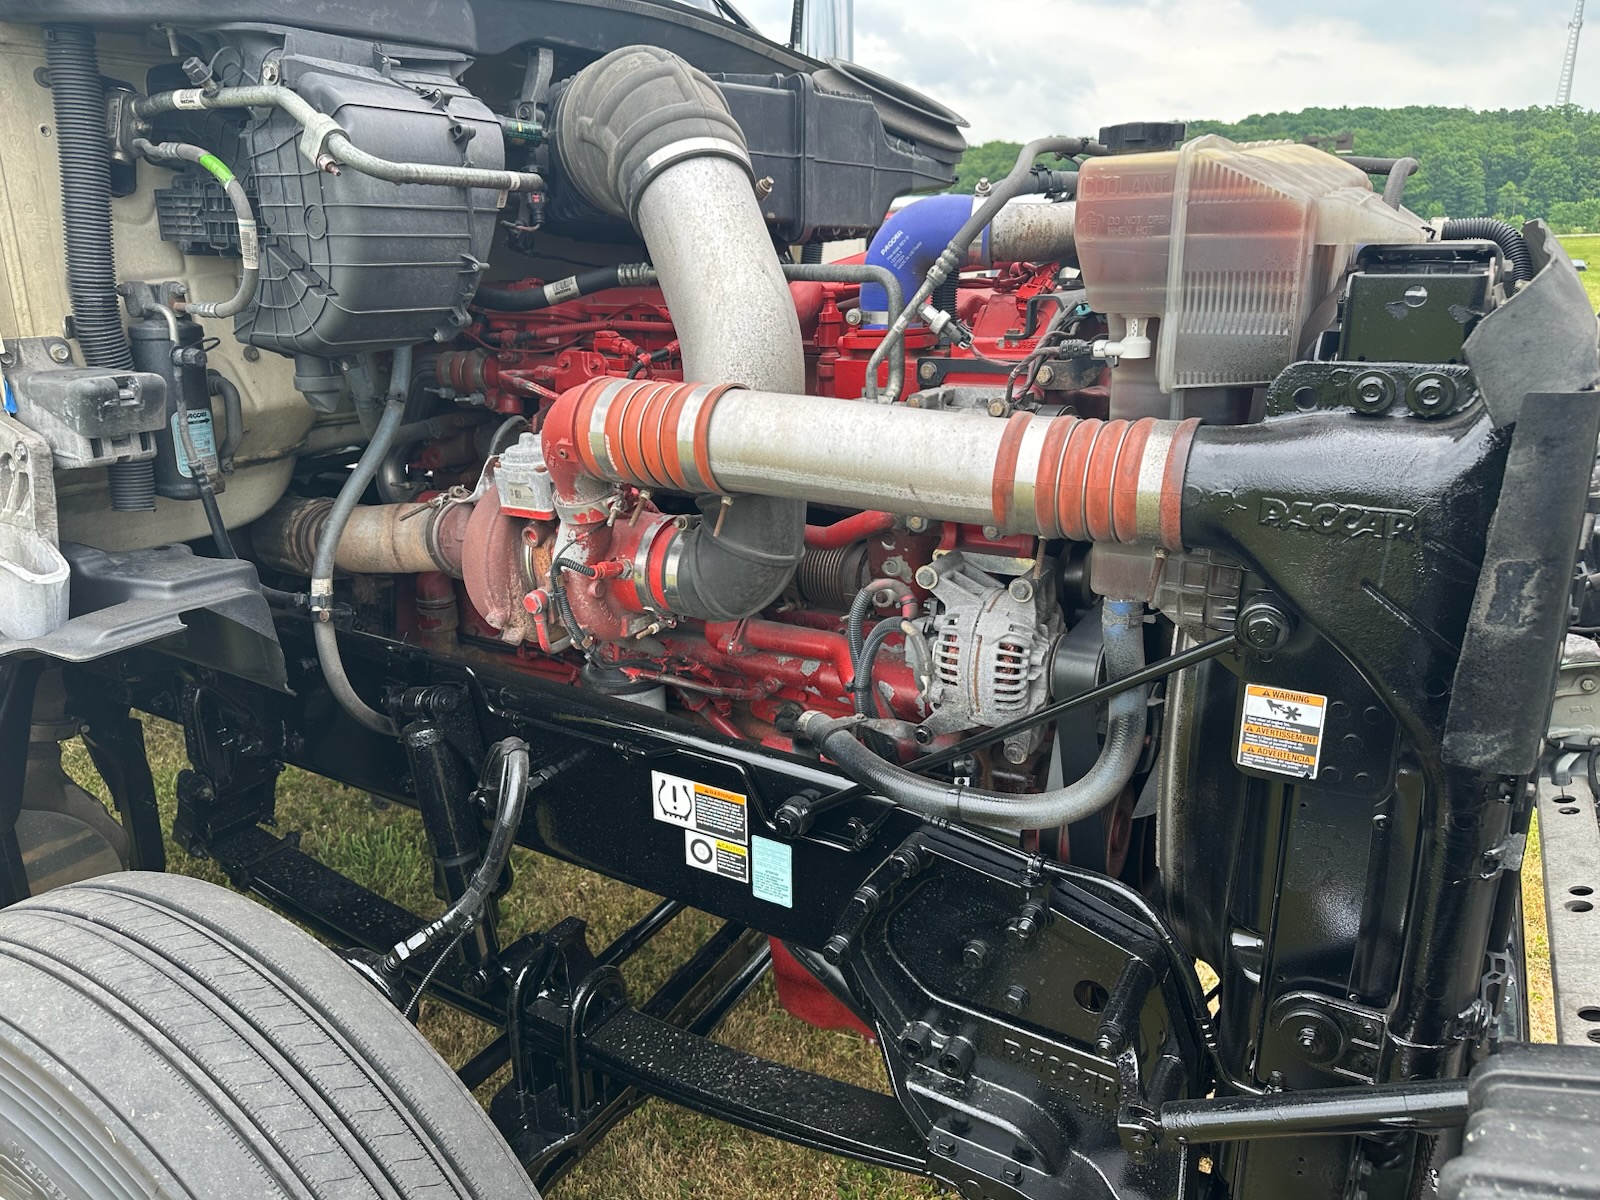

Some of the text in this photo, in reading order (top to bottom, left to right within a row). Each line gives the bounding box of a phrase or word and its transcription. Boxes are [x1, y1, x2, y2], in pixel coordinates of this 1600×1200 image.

[1083, 175, 1169, 196] COOLANT
[1108, 216, 1120, 225] DO
[1125, 215, 1142, 225] NOT
[1107, 225, 1154, 235] WHEN HOT
[880, 229, 904, 256] PACCAR
[1258, 497, 1417, 539] PACCAR
[1272, 691, 1310, 704] WARNING
[1255, 727, 1317, 744] AVERTISSEMENT
[1257, 747, 1310, 763] ADVERTENCIA
[721, 843, 747, 855] CAUTION
